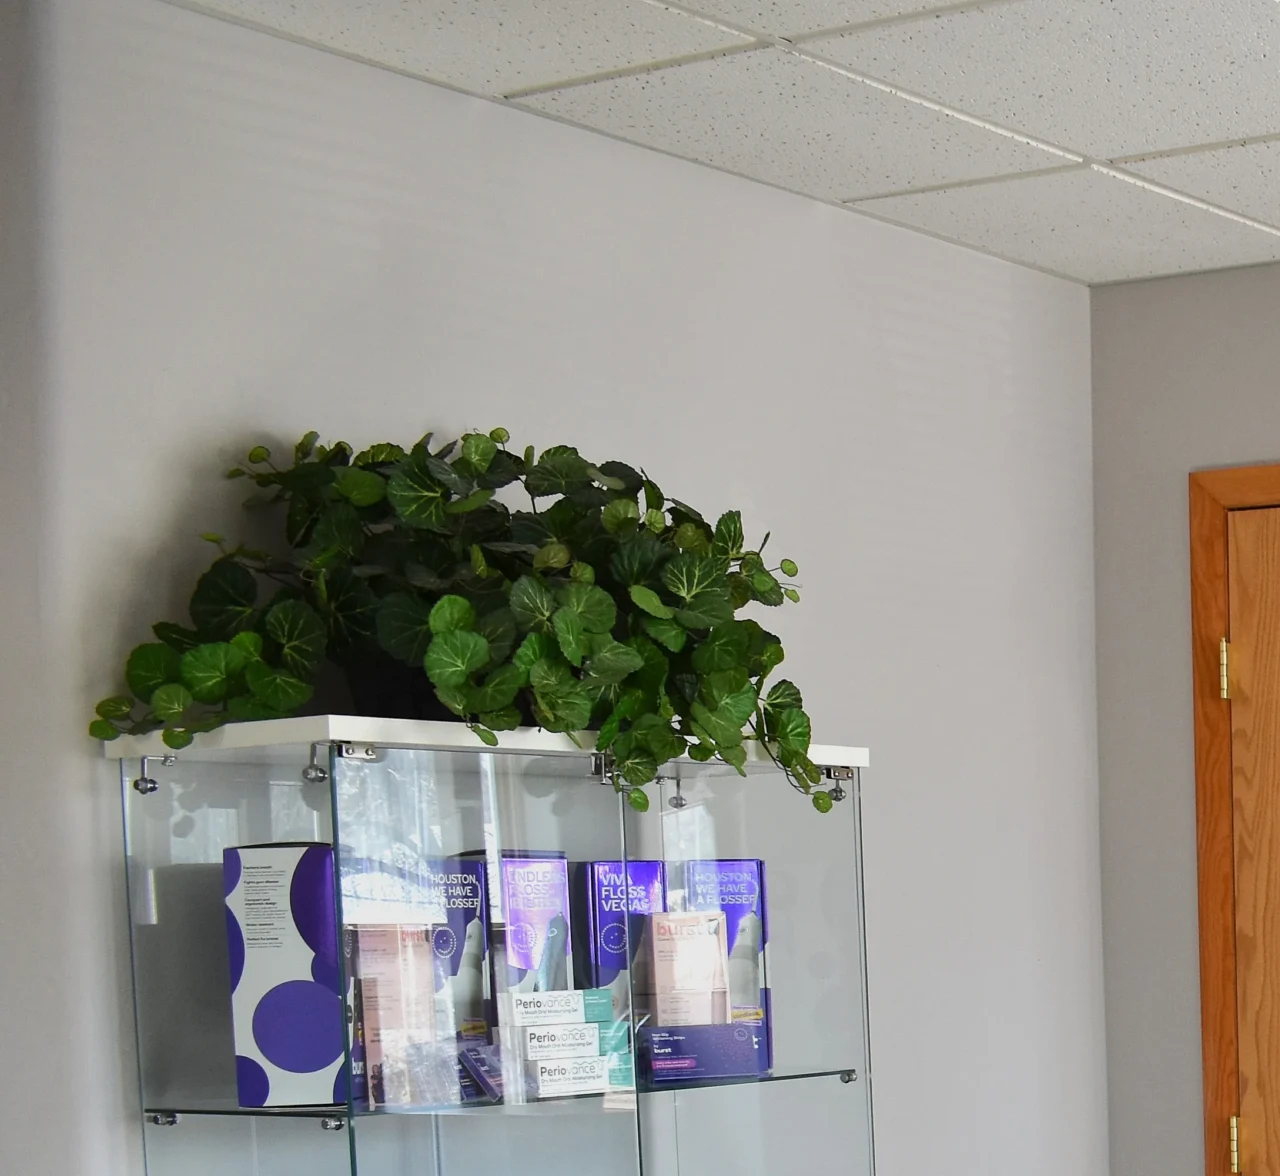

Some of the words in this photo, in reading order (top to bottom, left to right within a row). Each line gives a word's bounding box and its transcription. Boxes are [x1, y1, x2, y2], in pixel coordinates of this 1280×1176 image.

[449, 886, 473, 896] HAVE
[602, 886, 646, 899] FLOSS
[696, 884, 715, 893] WE
[718, 884, 747, 893] HAVE
[602, 898, 649, 912] VEGAS
[697, 895, 704, 904] A
[515, 997, 571, 1009] Periovance
[529, 1031, 586, 1043] Periovance
[540, 1065, 595, 1077] Periovance
